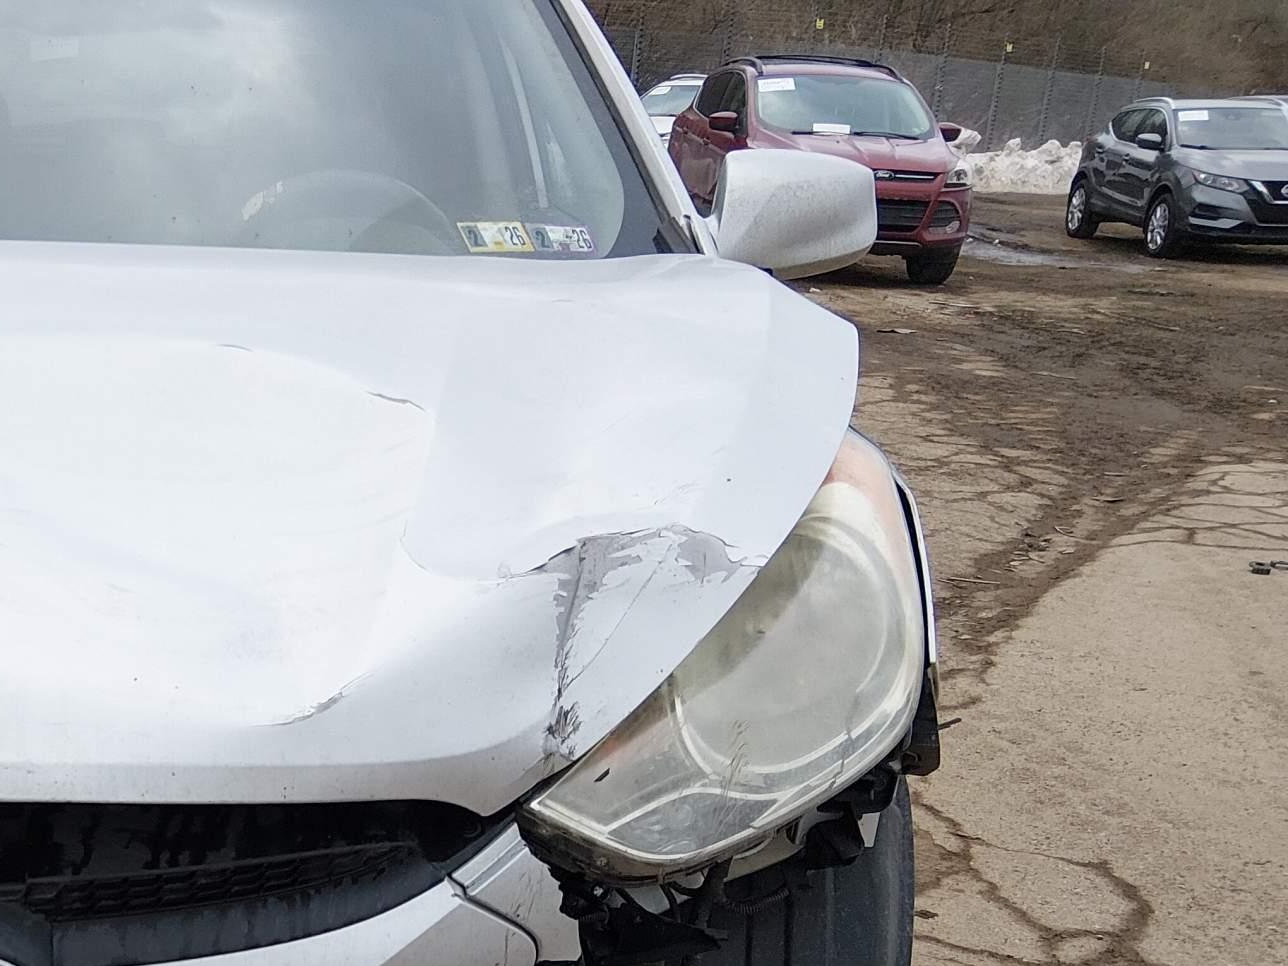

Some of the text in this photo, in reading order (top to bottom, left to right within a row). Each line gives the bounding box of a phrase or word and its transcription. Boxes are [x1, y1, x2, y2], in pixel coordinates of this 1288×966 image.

[467, 226, 526, 247] 2 26
[535, 229, 592, 249] 2 26
